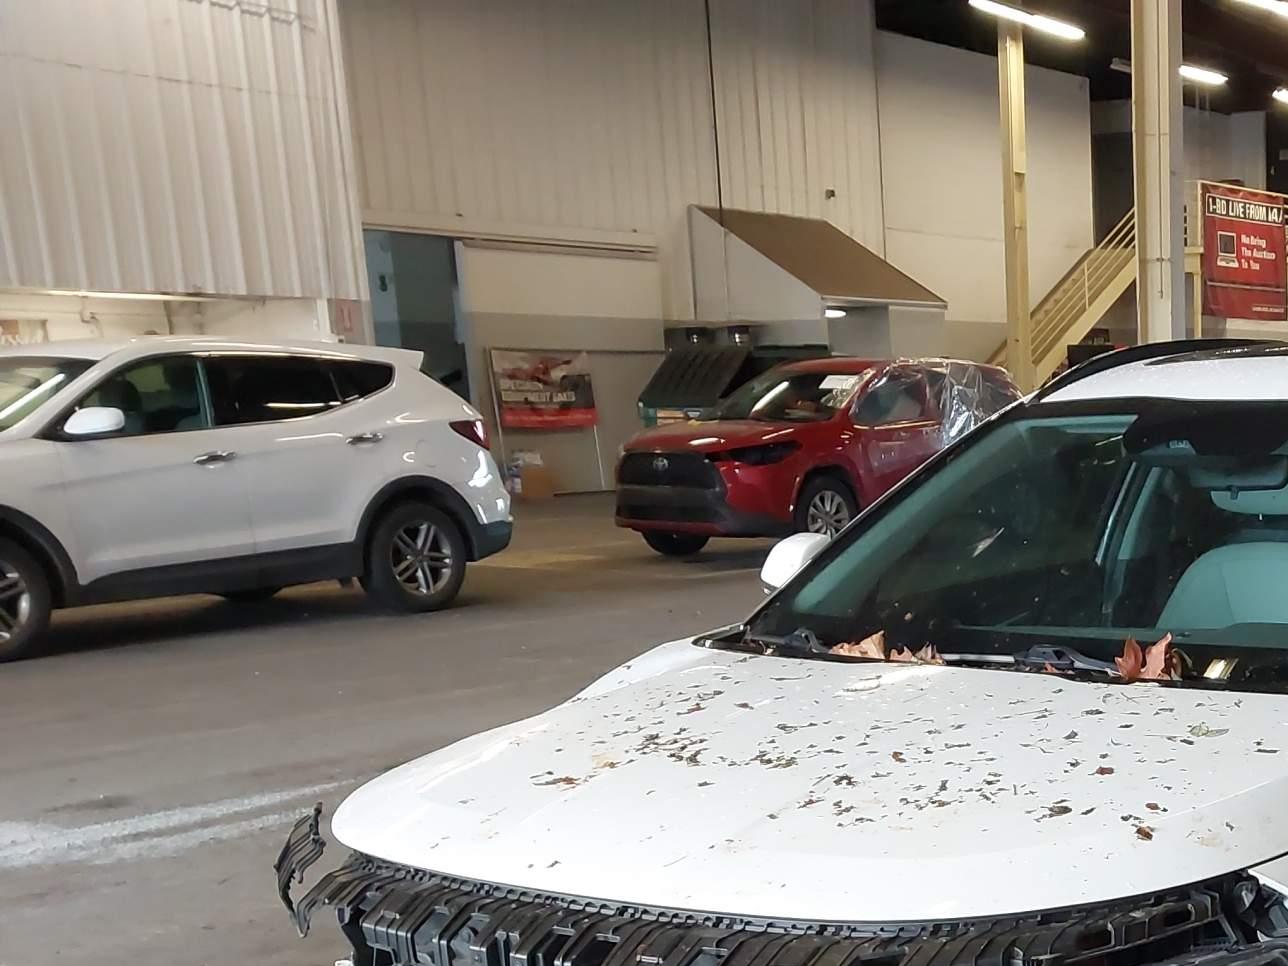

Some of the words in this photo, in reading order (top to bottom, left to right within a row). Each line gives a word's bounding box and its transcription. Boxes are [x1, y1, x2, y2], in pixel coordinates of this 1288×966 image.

[1229, 200, 1245, 218] LIVE
[1246, 203, 1267, 221] FROM
[1250, 235, 1266, 248] Bring
[1241, 247, 1252, 257] The
[1241, 259, 1248, 269] To
